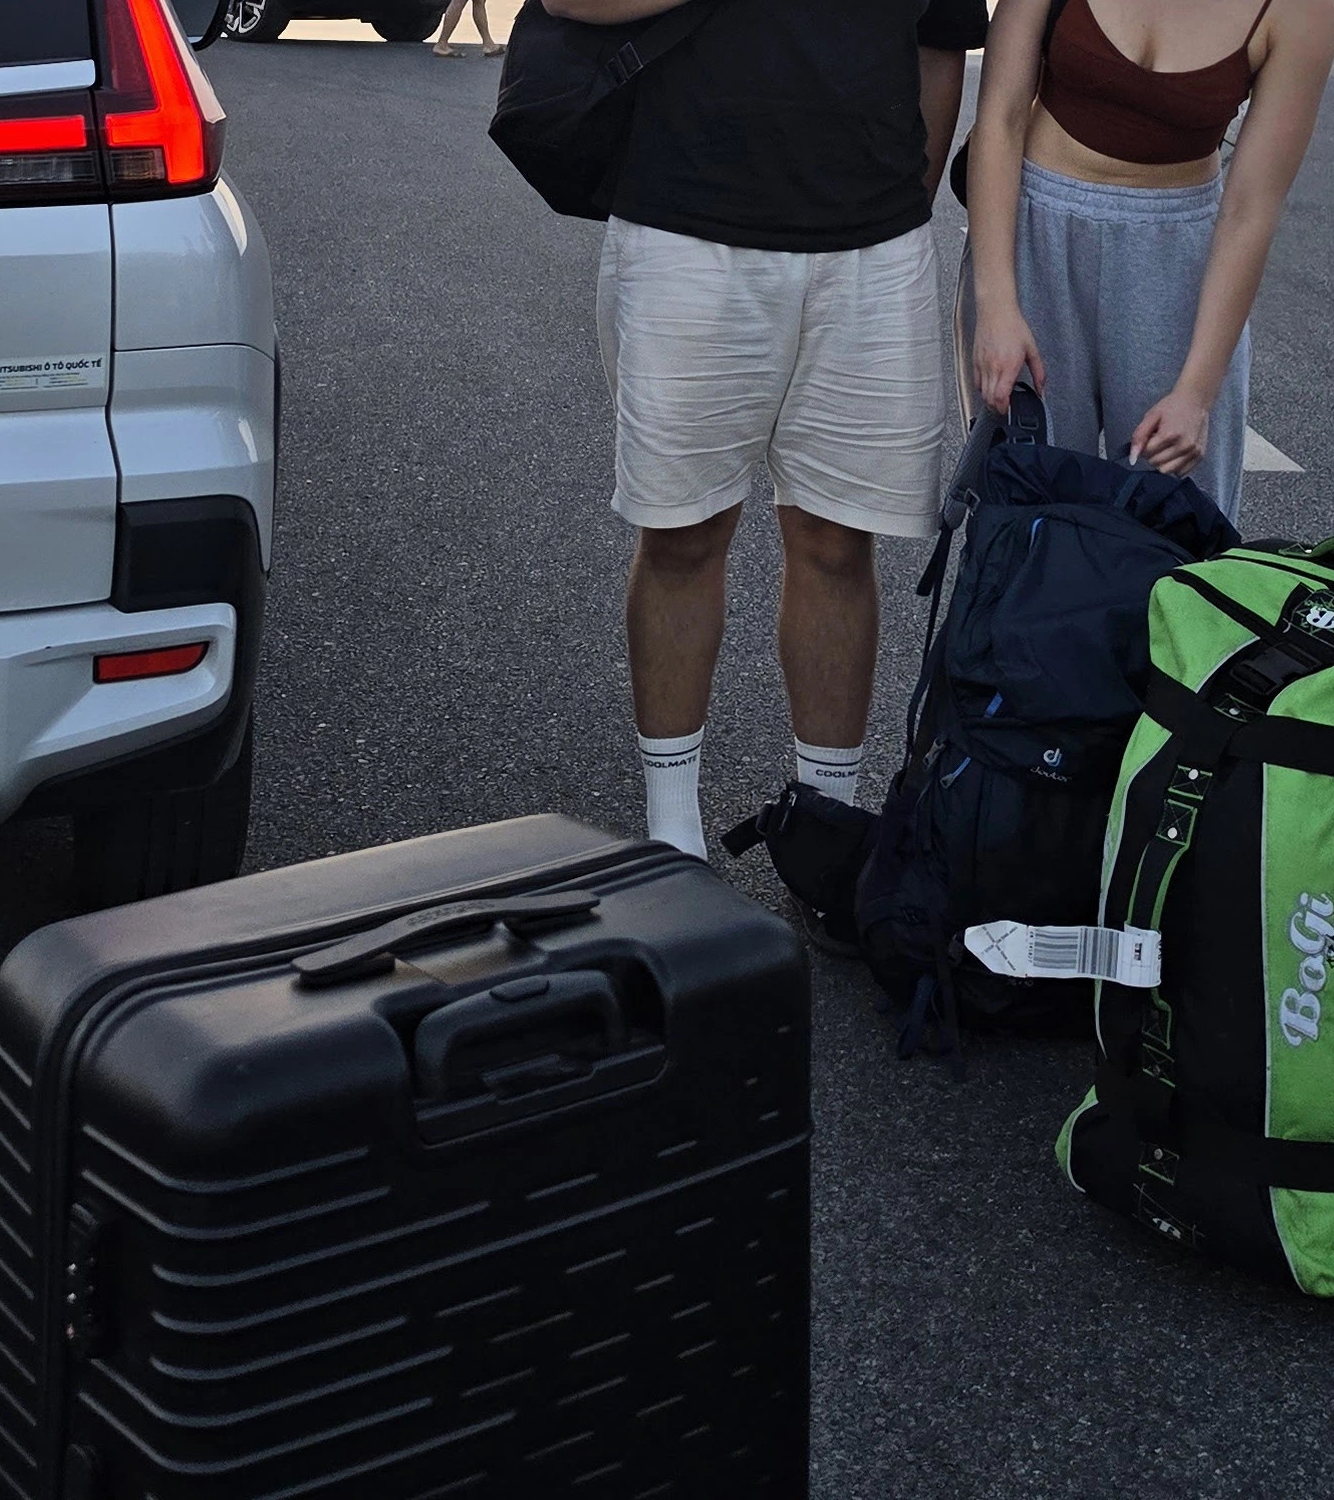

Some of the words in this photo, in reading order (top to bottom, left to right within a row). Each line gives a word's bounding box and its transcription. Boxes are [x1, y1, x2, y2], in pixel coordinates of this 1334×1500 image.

[43, 361, 51, 371] Ô
[52, 361, 64, 370] TÔ
[65, 358, 89, 371] QUỐC
